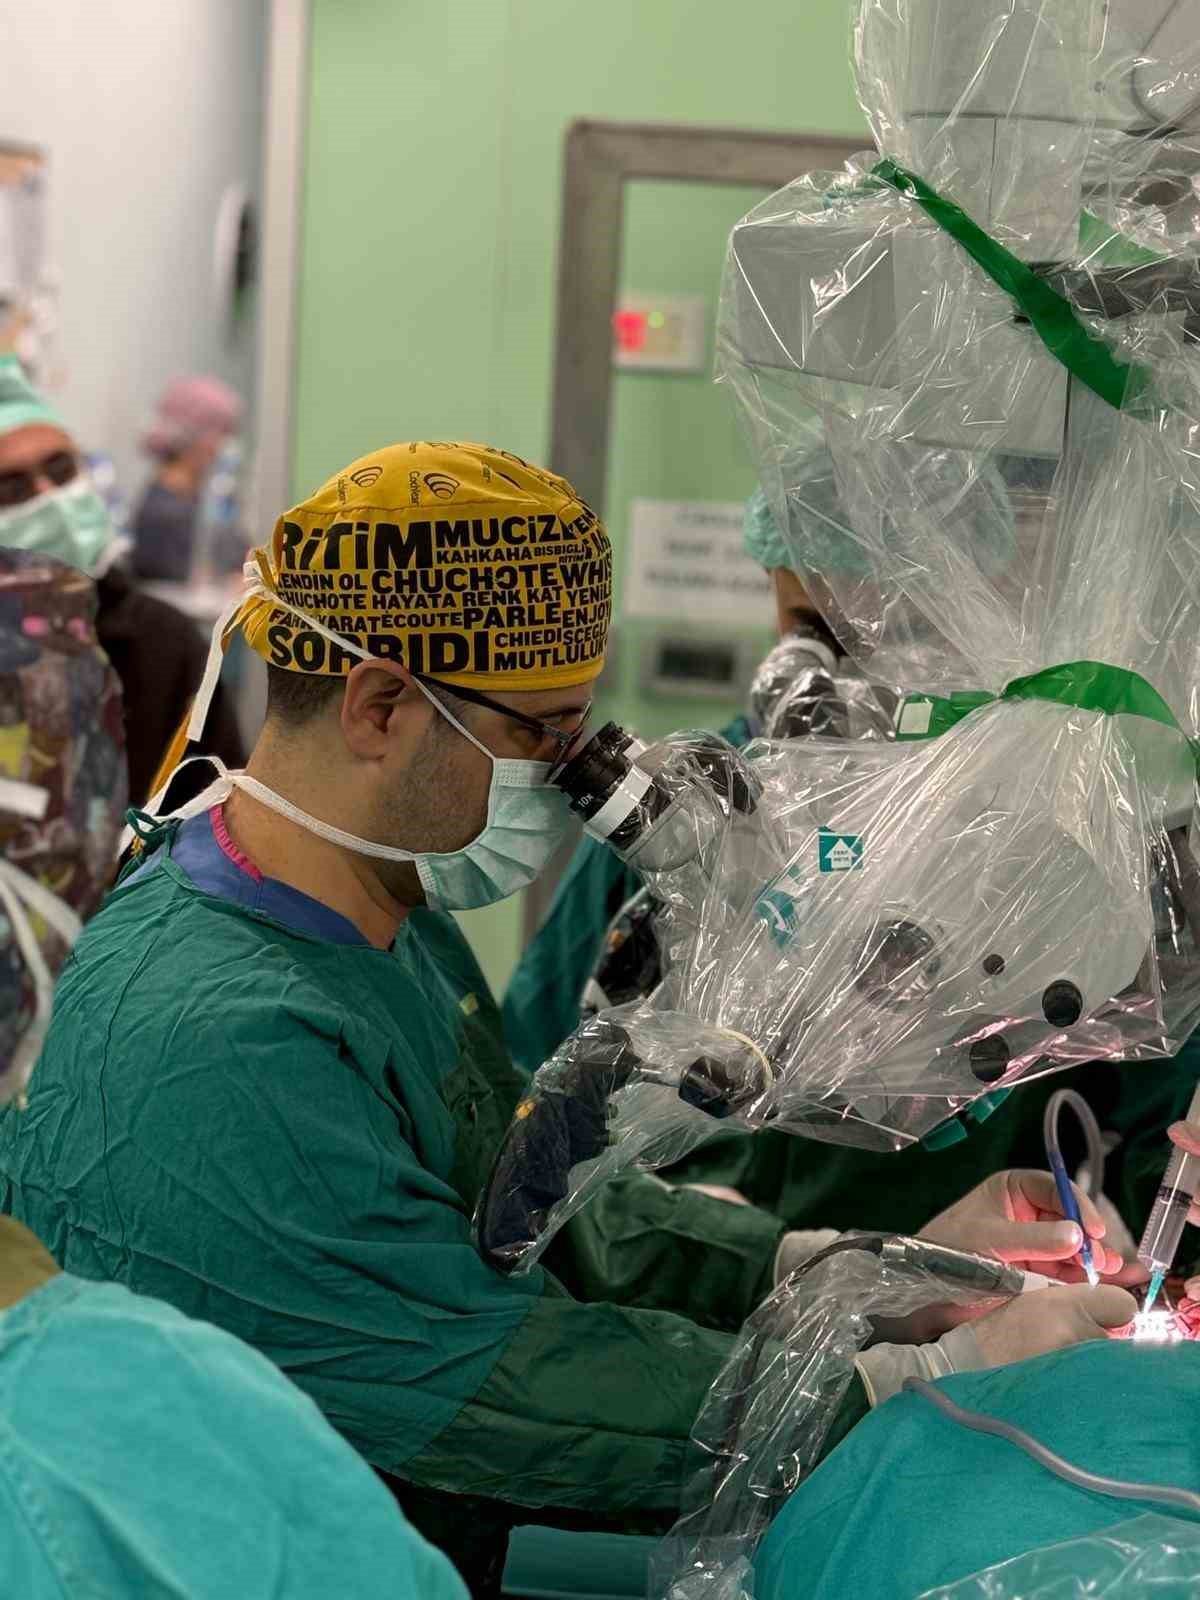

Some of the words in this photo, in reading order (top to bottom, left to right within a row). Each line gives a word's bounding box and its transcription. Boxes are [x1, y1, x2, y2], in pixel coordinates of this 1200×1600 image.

[436, 546, 532, 564] KAHKAHA
[339, 573, 368, 590] OL
[372, 593, 457, 610] HAYATA
[462, 589, 522, 607] RENK
[527, 585, 563, 604] KAT
[463, 603, 562, 630] PARLE
[495, 627, 562, 648] CHIEDI
